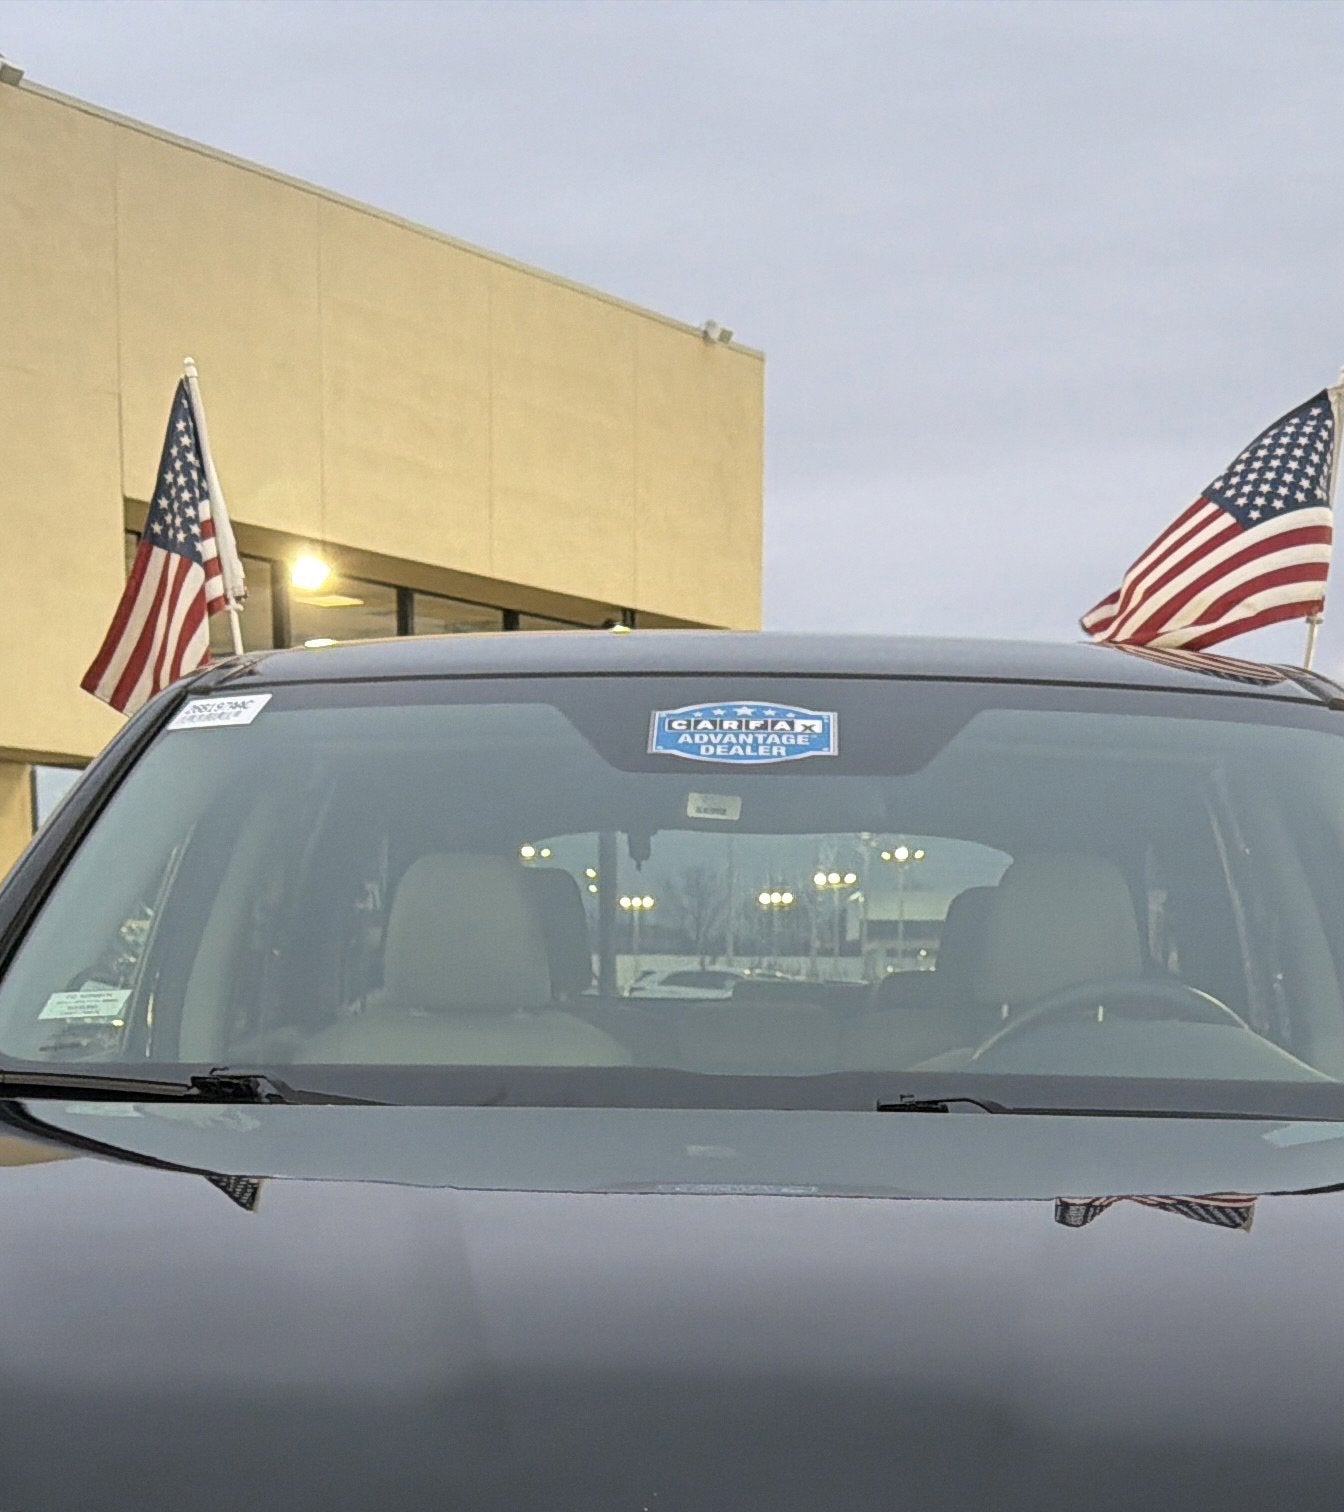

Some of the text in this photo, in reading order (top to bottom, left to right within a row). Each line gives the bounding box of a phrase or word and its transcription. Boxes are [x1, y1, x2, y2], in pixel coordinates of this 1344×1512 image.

[668, 718, 823, 733] CARFAX
[677, 733, 810, 746] ADVANTAGE
[699, 744, 786, 757] DEALER
